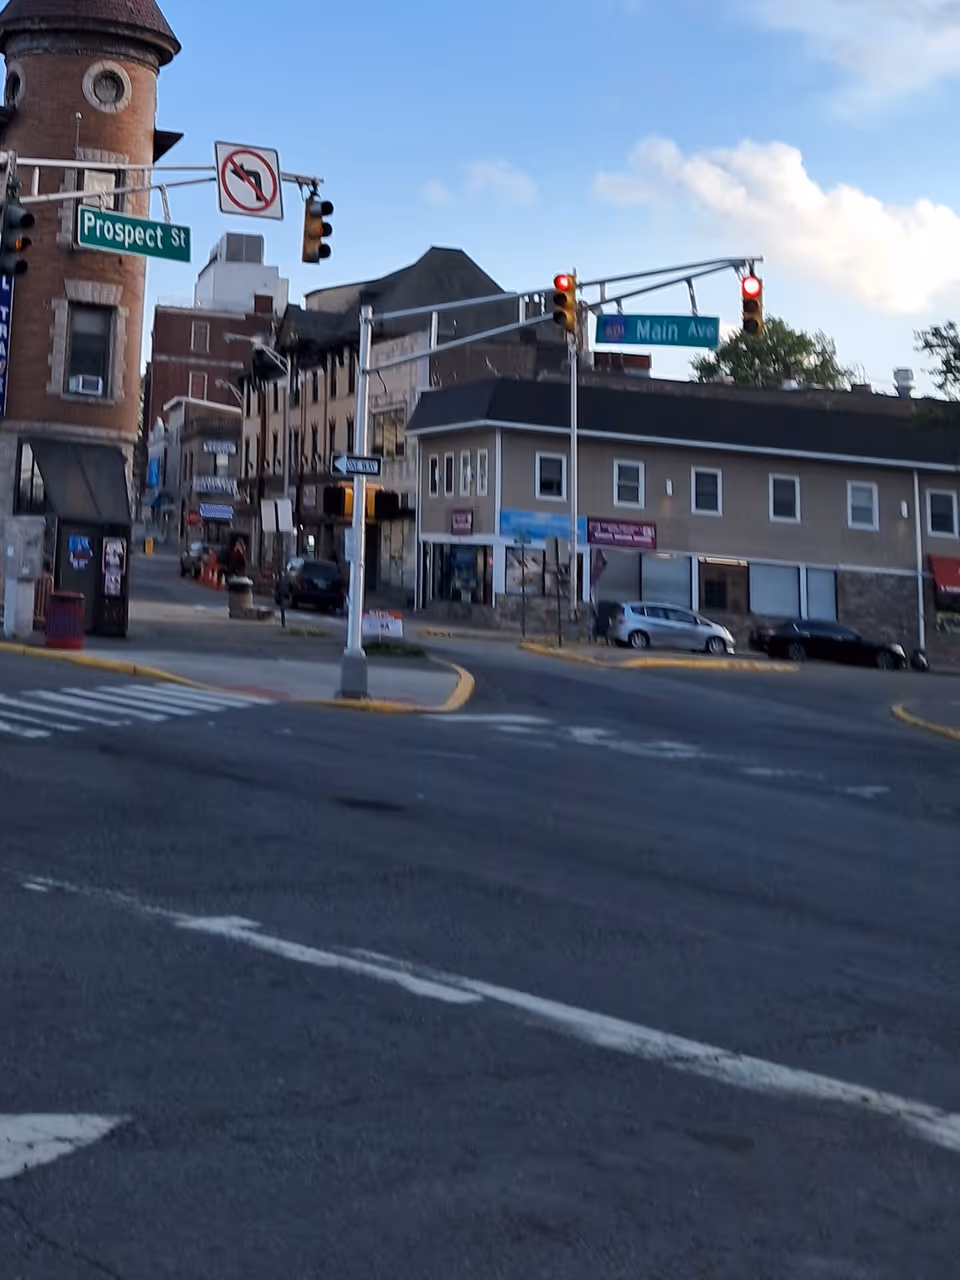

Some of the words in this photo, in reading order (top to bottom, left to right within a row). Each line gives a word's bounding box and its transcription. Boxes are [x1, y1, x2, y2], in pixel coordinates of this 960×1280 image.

[83, 211, 164, 249] Prospect
[171, 228, 187, 248] St
[636, 320, 679, 341] Main
[688, 321, 715, 339] Ave
